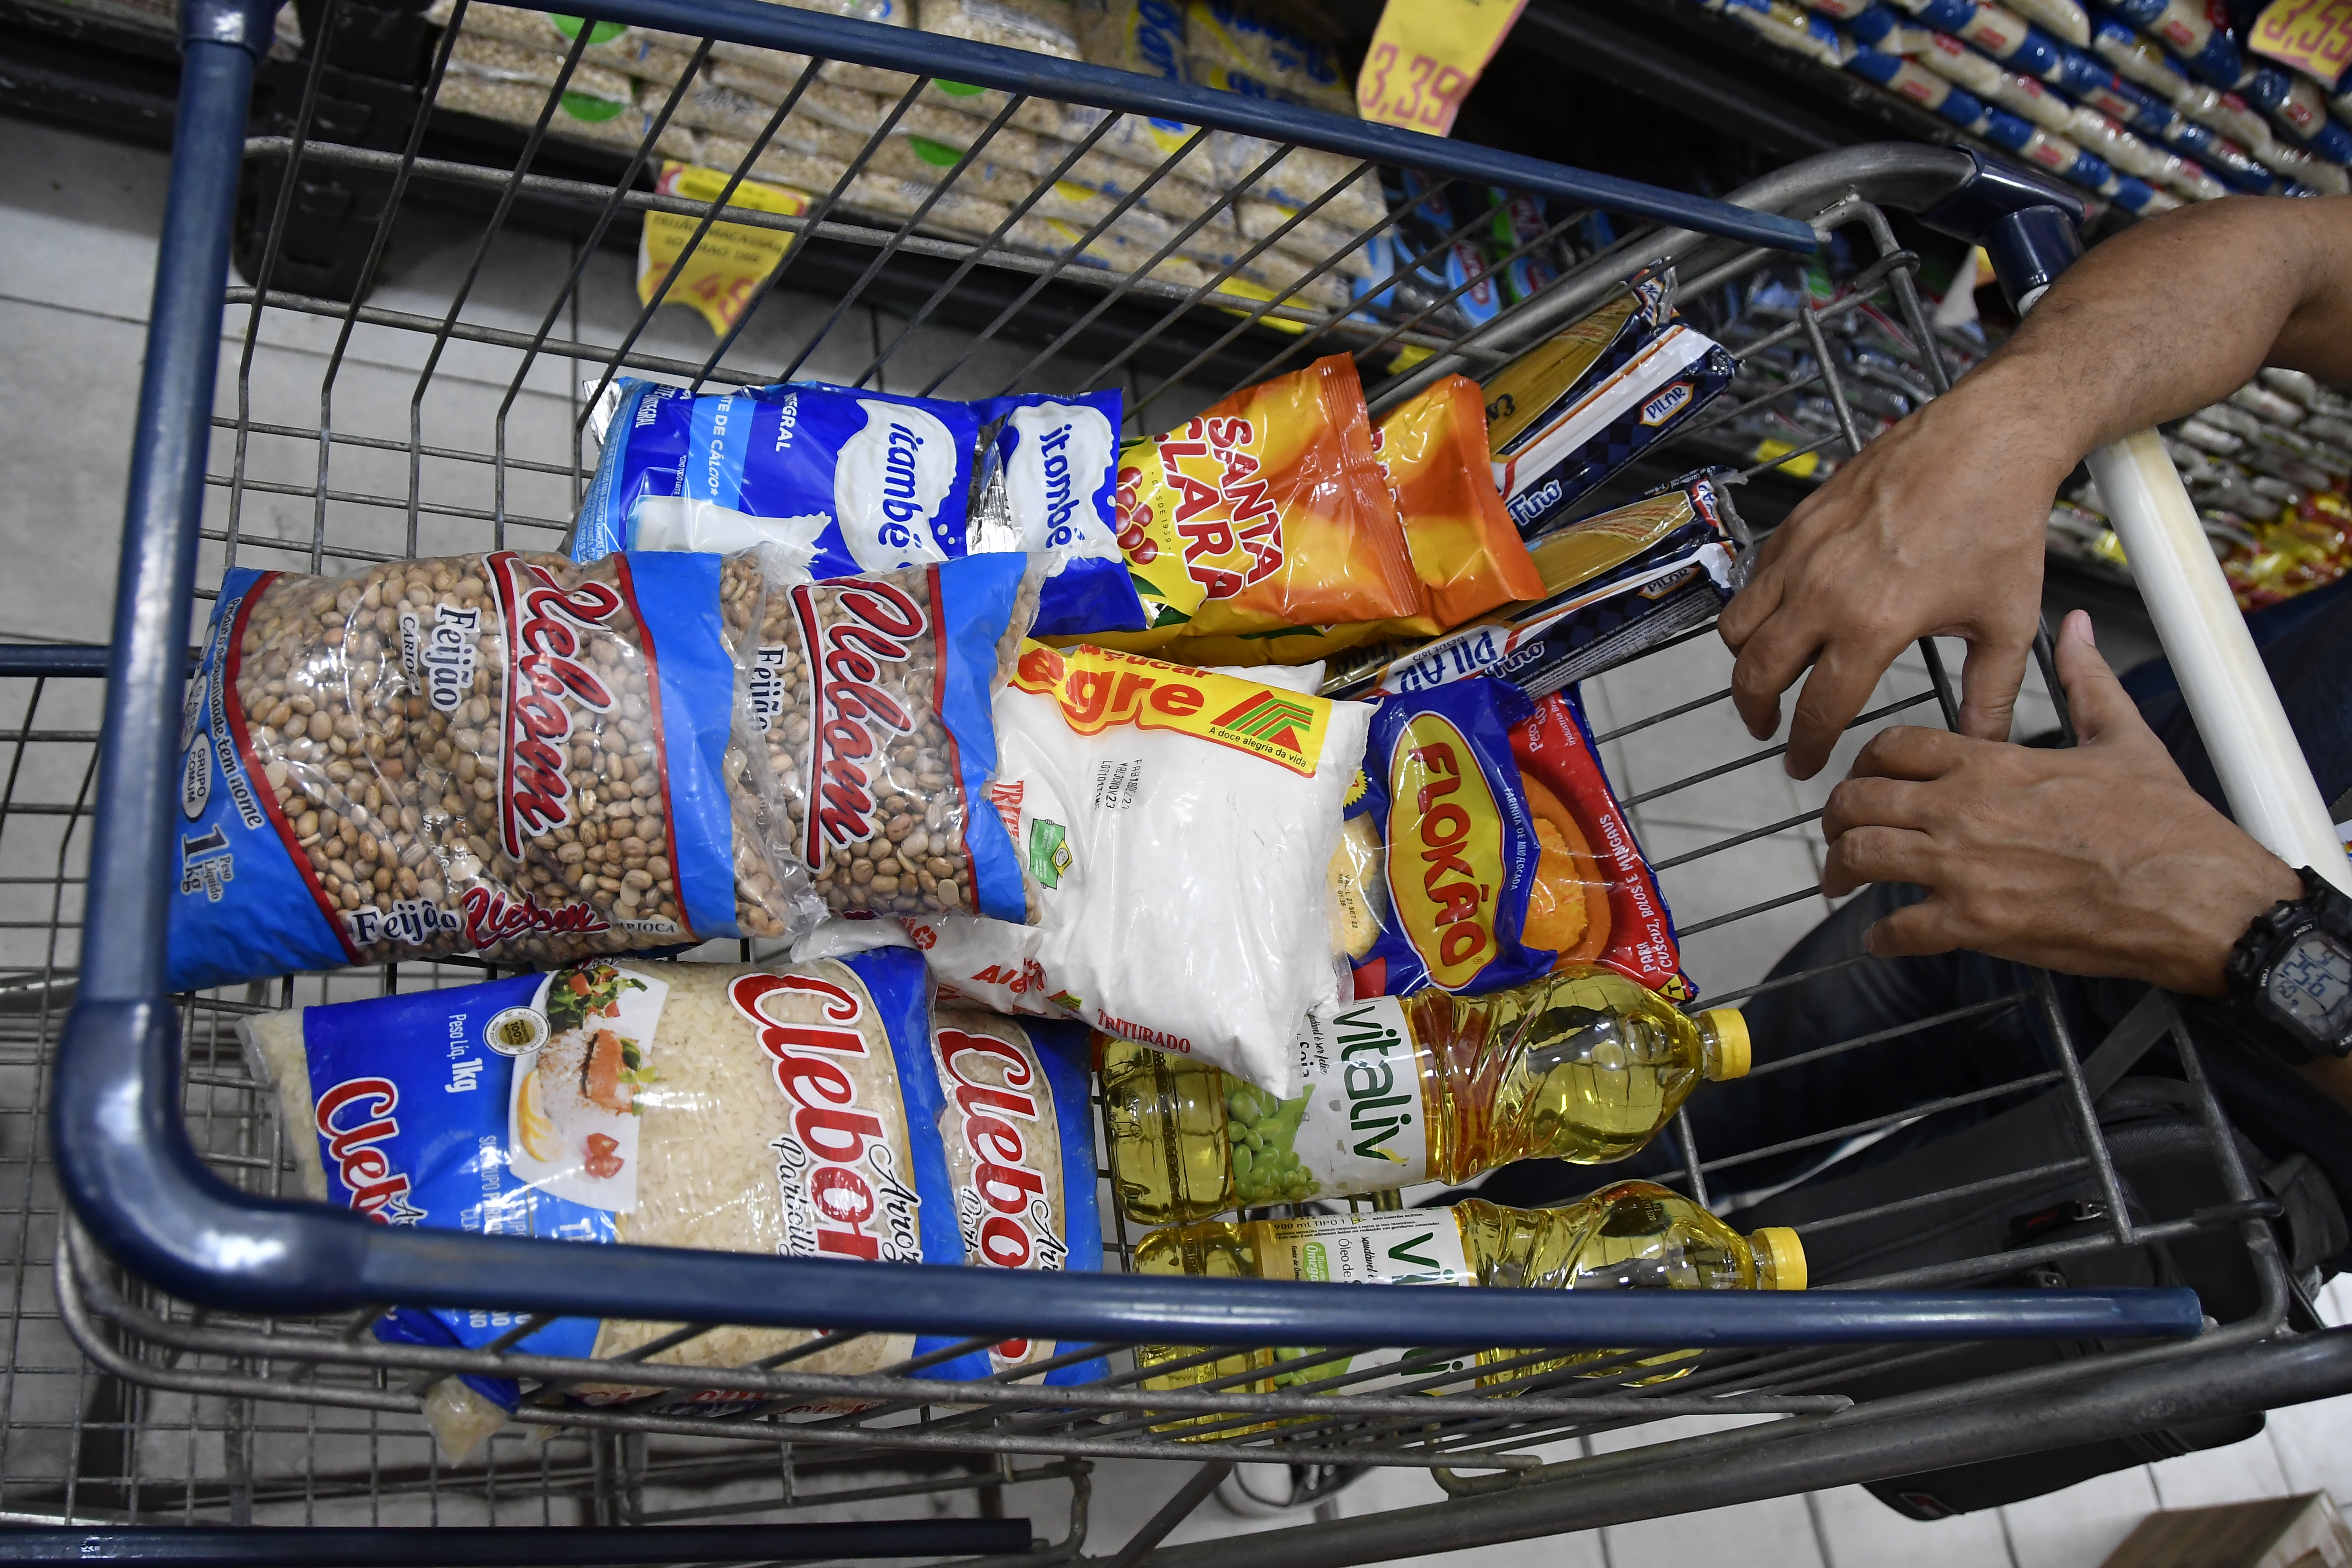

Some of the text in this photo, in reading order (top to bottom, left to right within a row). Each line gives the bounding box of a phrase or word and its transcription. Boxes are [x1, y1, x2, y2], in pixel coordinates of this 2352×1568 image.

[1361, 42, 1469, 127] 3,39
[1646, 386, 1685, 419] PILAR
[713, 414, 727, 436] DE
[674, 482, 682, 495] LEITE
[676, 468, 685, 482] TODO
[1152, 480, 1171, 543] DESDE 1959
[1155, 417, 1245, 599] CLARA
[1206, 416, 1285, 586] SANTA
[1647, 568, 1690, 592] PILAR
[425, 607, 477, 706] Feijão
[1395, 630, 1497, 693] PILAR
[1413, 636, 1465, 661] DESDE 1875
[211, 598, 262, 826] Produto de qualidade tem nome
[1209, 726, 1307, 768] A doce alegria da vida
[1529, 724, 1544, 752] Peso
[187, 751, 196, 802] COMUM
[197, 748, 206, 797] GRUPO
[1408, 741, 1491, 966] FLOKÃO
[1504, 787, 1527, 891] FARINHA DE MILHO FLOCADA
[205, 859, 220, 900] Líquido
[220, 856, 232, 881] Peso
[1337, 890, 1347, 906] 01:35
[1600, 814, 1673, 969] CUSCUZ, BOLOS E MINGAUS
[352, 899, 457, 942] Feijão
[1636, 942, 1656, 973] PARA
[1668, 985, 1682, 996] T
[448, 1014, 466, 1037] Peso
[1098, 1008, 1191, 1054] TRITURADO
[1314, 1055, 1330, 1075] feliz
[1315, 1043, 1325, 1055] ser
[446, 1058, 483, 1093] 1kg
[733, 973, 884, 1261] Clebo
[316, 1078, 408, 1224] Cleb
[937, 1031, 1045, 1267] Clebo
[1338, 1238, 1354, 1278] Óleo de
[1361, 1236, 1378, 1273] saudável
